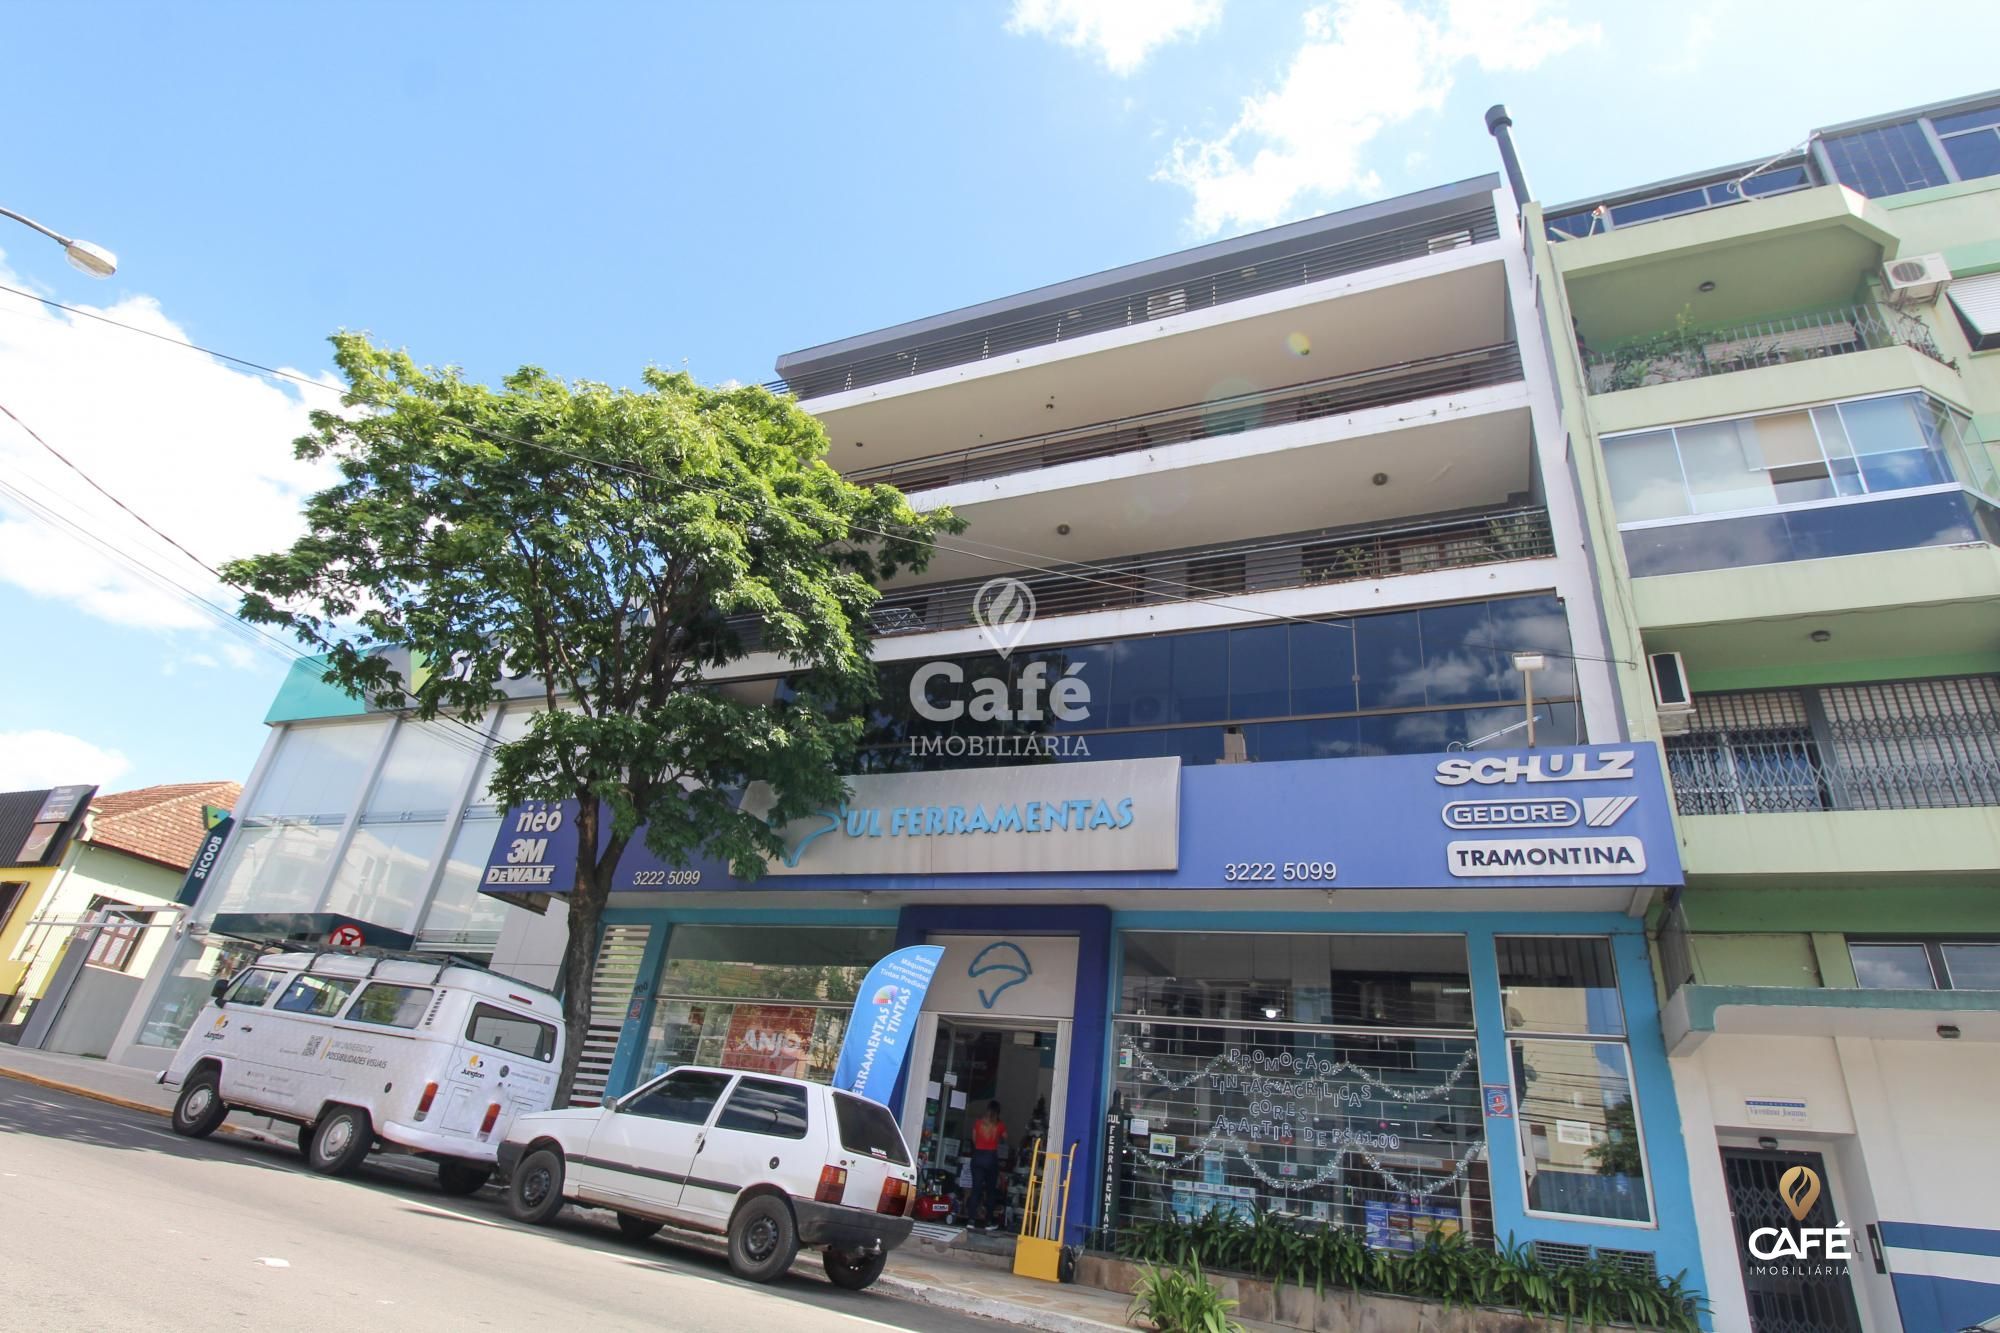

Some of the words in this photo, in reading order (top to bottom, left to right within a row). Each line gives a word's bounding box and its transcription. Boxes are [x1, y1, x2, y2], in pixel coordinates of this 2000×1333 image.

[1434, 750, 1635, 785] SCHULZ
[891, 797, 1134, 837] FERRAMENTAS
[1453, 803, 1569, 823] GEDORE
[194, 836, 222, 879] SICOOB
[507, 838, 548, 864] 3M
[1456, 846, 1635, 867] TRAMONTINA
[632, 871, 664, 885] 3222
[667, 870, 701, 885] 5099
[1224, 862, 1276, 881] 3222
[1283, 861, 1337, 881] 5099
[880, 967, 900, 979] Tintas
[888, 962, 930, 982] Ferramentas
[888, 987, 912, 1035] TINTAS
[852, 1005, 890, 1097] ERRAMENTAS
[883, 1036, 895, 1046] E
[1230, 1049, 1331, 1075] PROMOÇÃO
[1210, 1073, 1272, 1098] TINTAS
[1250, 1099, 1308, 1122] CORES
[1304, 1126, 1327, 1147] DE
[1102, 1126, 1116, 1234] FERRAMENTAS
